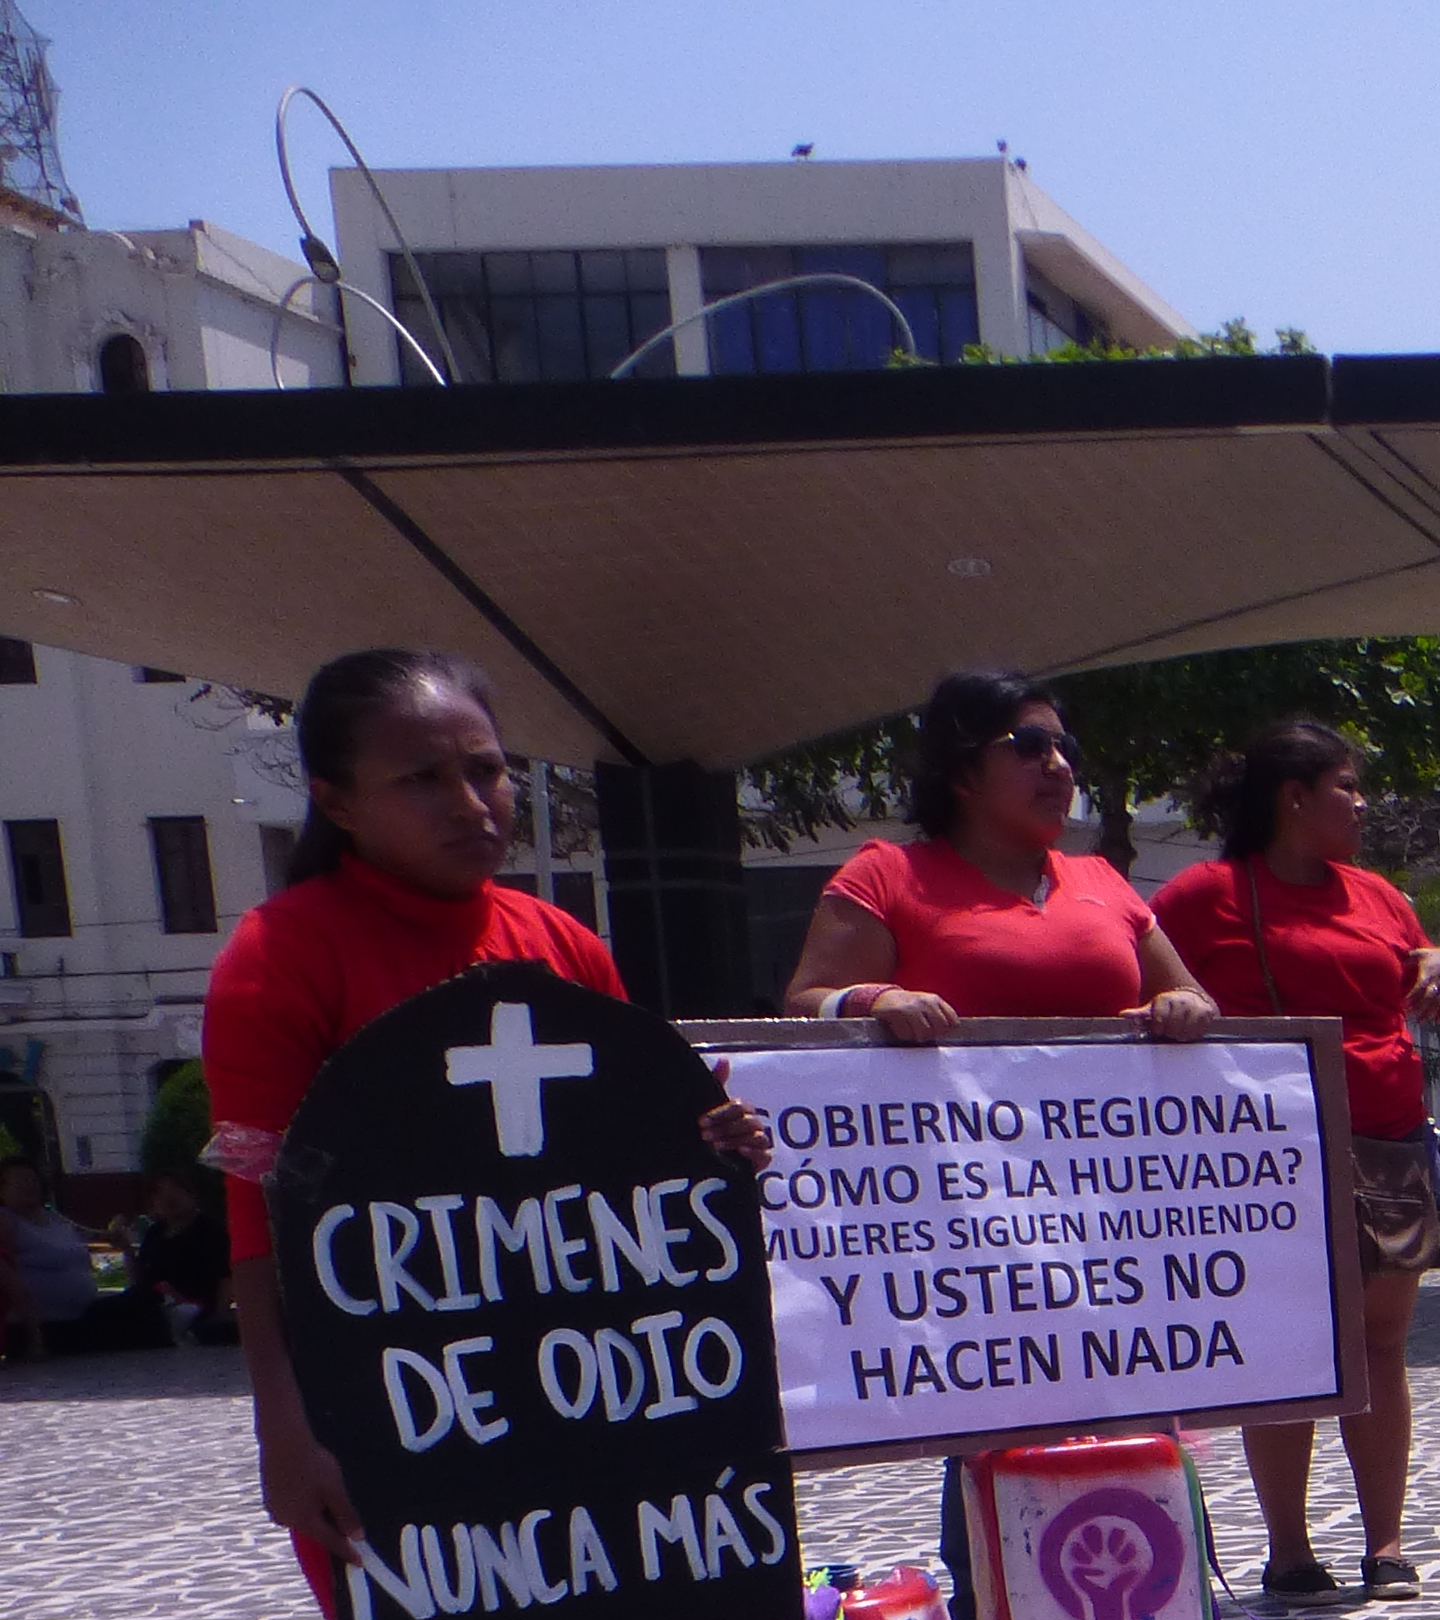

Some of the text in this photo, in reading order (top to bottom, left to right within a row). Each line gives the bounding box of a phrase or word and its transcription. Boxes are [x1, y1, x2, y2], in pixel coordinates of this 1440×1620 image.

[1039, 1092, 1287, 1141] REGIONAL
[757, 1146, 1302, 1211] CÓMO ES LA HUEVADA?
[312, 1176, 740, 1315] CRIMENES
[948, 1212, 1087, 1249] SIGUEN
[1100, 1201, 1296, 1241] MURIENDO
[821, 1250, 1245, 1326] Y USTEDES NO
[383, 1310, 743, 1453] DE ODIO
[850, 1321, 1244, 1399] HACEN NADA
[637, 1466, 785, 1581] MÁS
